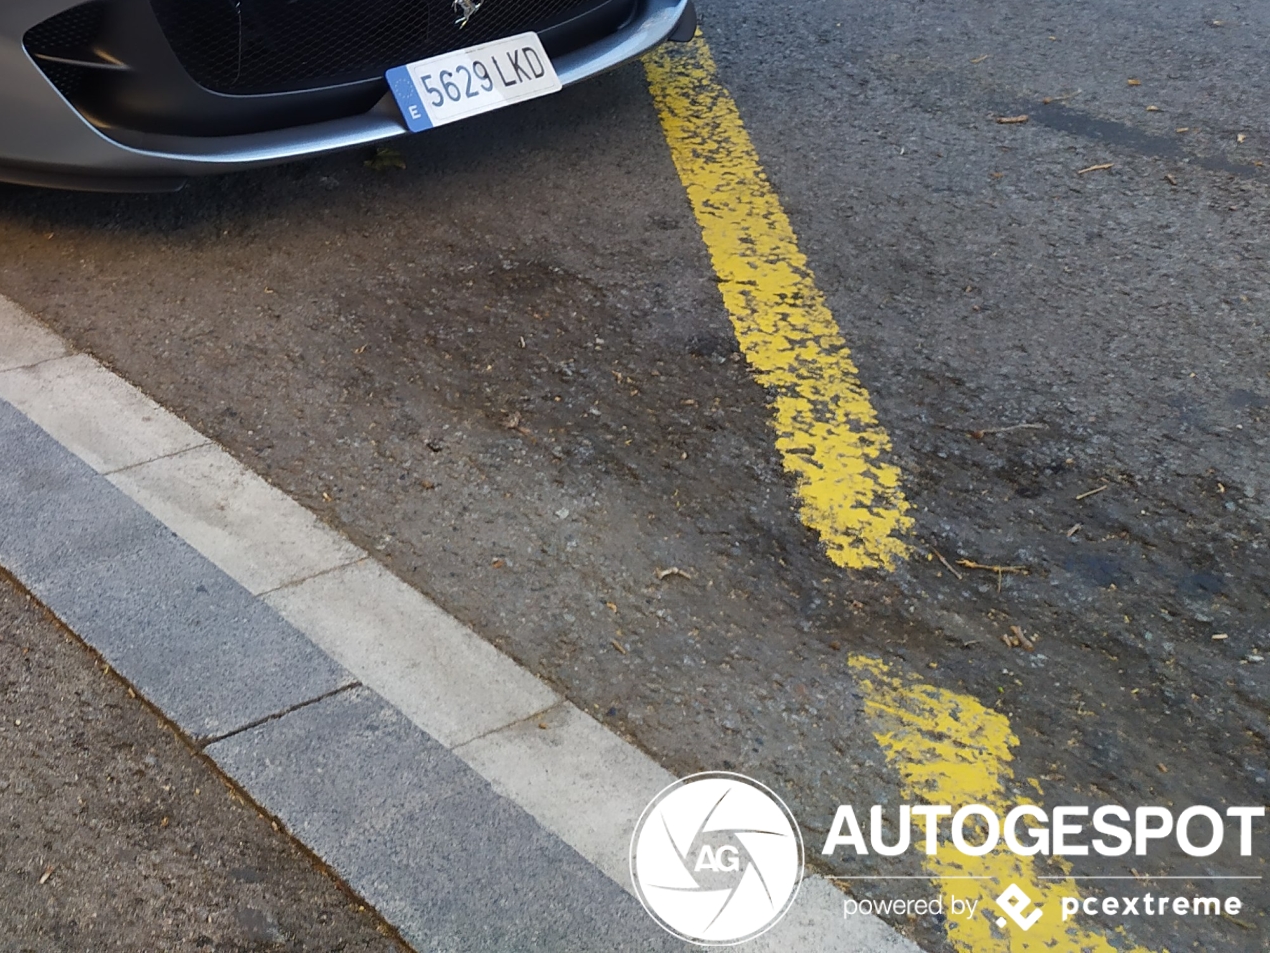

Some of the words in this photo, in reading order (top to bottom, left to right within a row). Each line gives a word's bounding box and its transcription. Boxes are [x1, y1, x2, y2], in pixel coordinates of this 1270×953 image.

[420, 60, 494, 107] 5629
[491, 46, 545, 87] LKD
[408, 105, 421, 119] E
